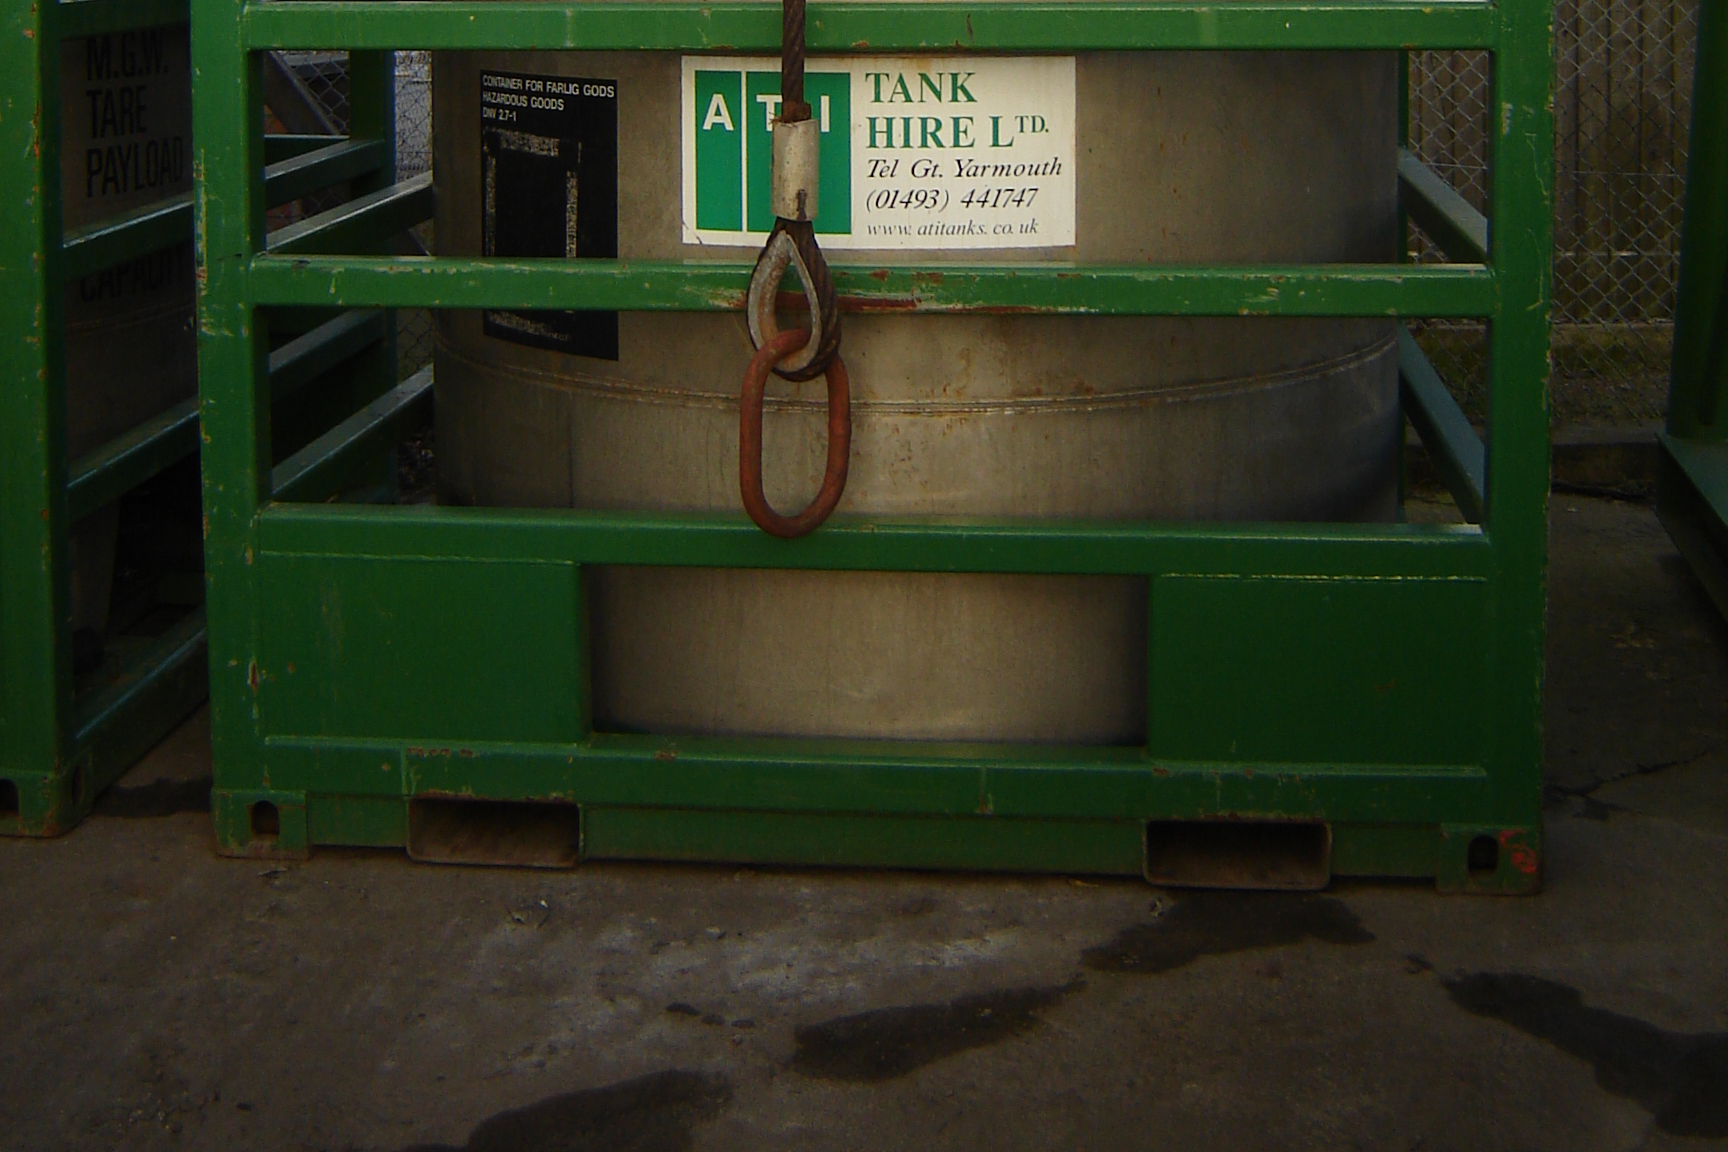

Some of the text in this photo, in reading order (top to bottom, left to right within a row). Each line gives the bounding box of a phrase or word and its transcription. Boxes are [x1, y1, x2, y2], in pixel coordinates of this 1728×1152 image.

[483, 74, 615, 98] CONTAINER FOR FARLIG GODS
[865, 71, 977, 104] TANK
[86, 85, 147, 138] TARE
[483, 91, 564, 111] HAZARDOUS GOODS
[866, 116, 975, 148] HIRE
[86, 136, 183, 197] PAYLOAD
[867, 156, 1062, 179] Tel Gt. Yarmouth
[866, 188, 1038, 212] (01493) 441747
